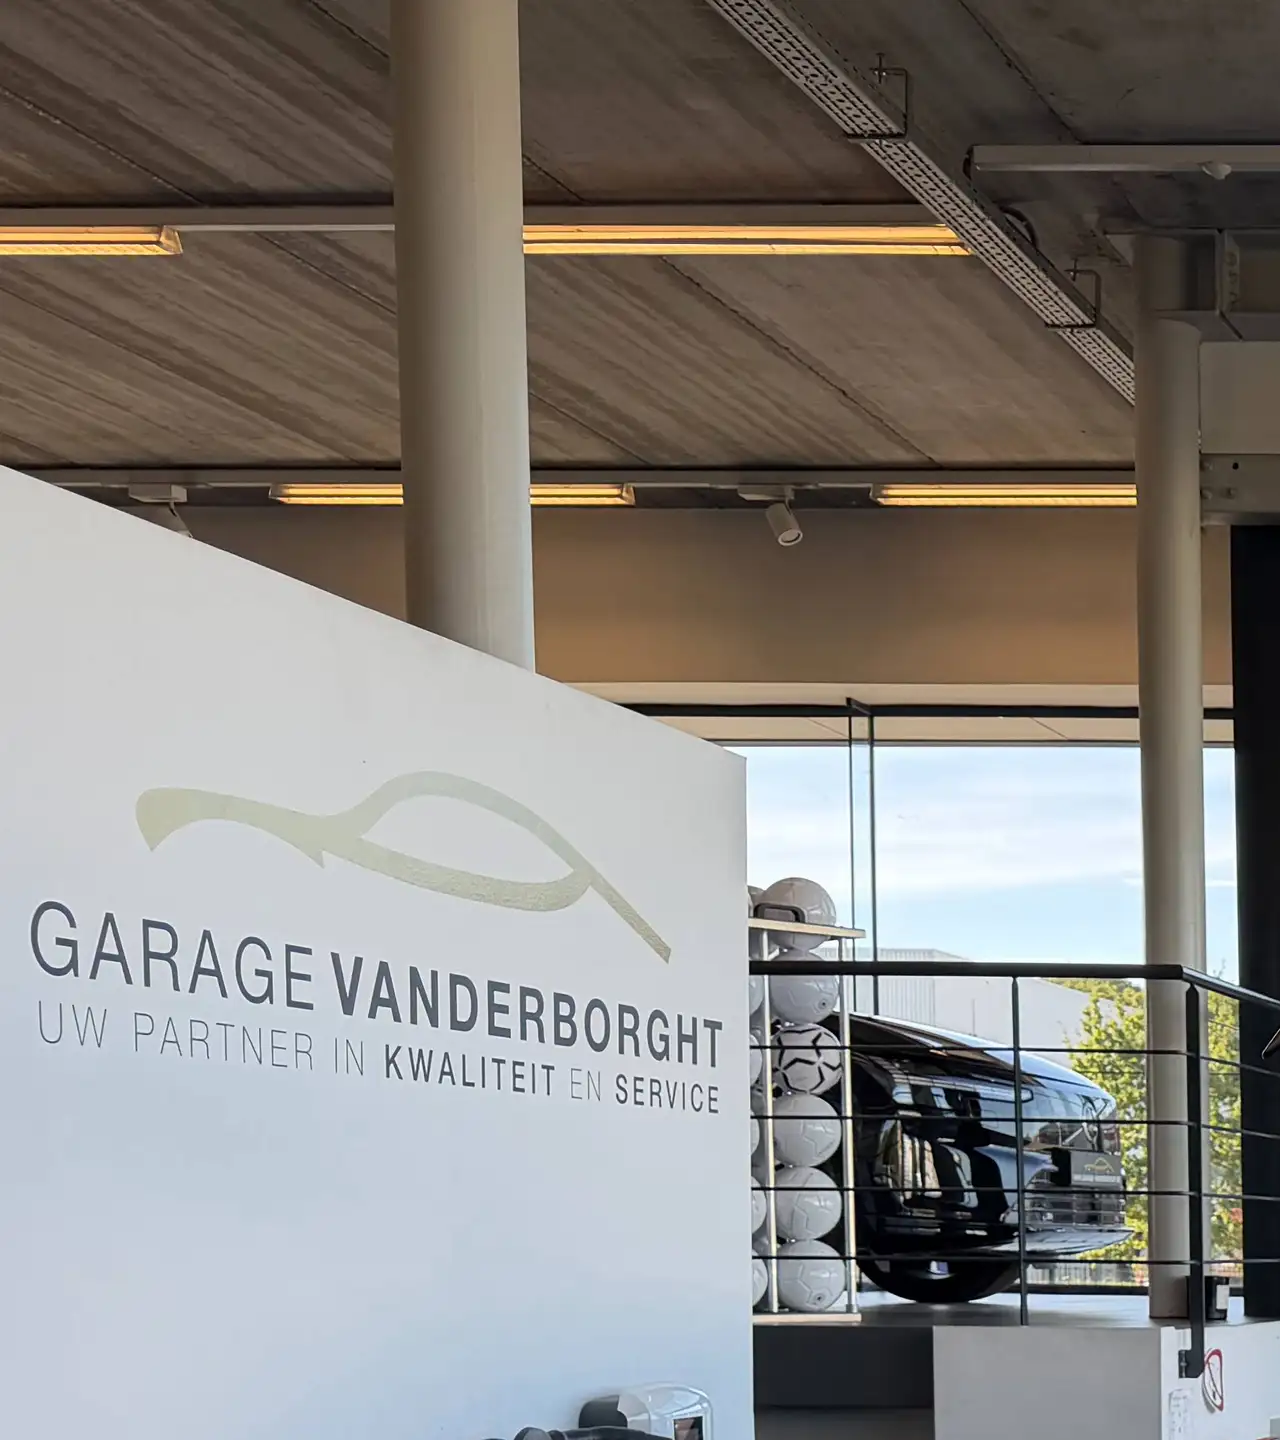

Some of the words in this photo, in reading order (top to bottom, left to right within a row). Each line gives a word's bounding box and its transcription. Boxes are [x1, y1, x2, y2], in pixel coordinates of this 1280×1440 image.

[30, 900, 315, 1011] GARAGE
[329, 951, 724, 1069] VANDERBORGHT
[38, 999, 108, 1049] UW
[133, 1011, 314, 1072] PARTNER
[334, 1036, 365, 1077] IN
[384, 1043, 556, 1098] KWALITEIT
[570, 1067, 603, 1104] EN
[615, 1073, 720, 1115] SERVICE
